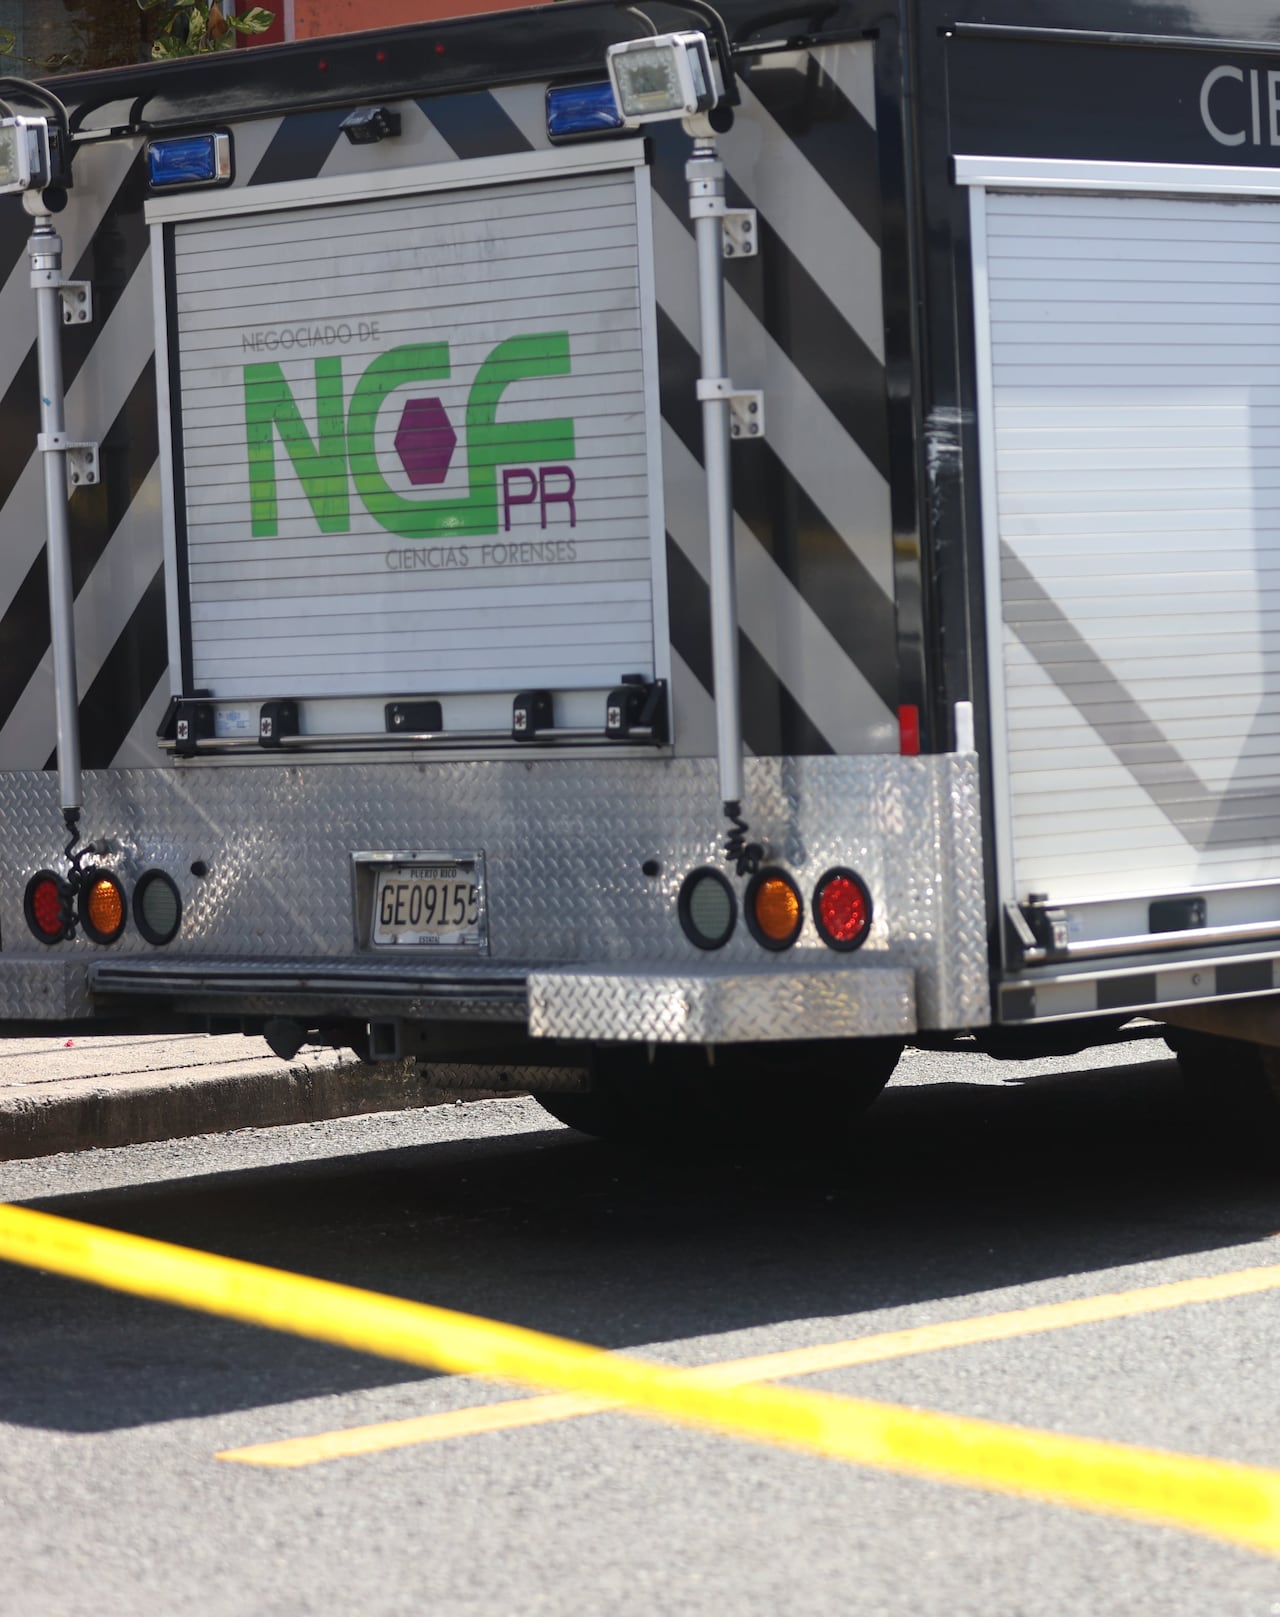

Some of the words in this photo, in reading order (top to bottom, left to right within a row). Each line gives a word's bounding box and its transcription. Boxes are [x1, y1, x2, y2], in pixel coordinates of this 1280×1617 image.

[243, 323, 352, 353] NEGOCIADO
[359, 320, 381, 341] DE
[502, 465, 576, 531] PR
[385, 546, 469, 571] CIENCIAS
[481, 539, 577, 566] FORENSES
[410, 869, 438, 879] PUERTO
[440, 869, 457, 878] RICO
[380, 884, 479, 925] GE09155
